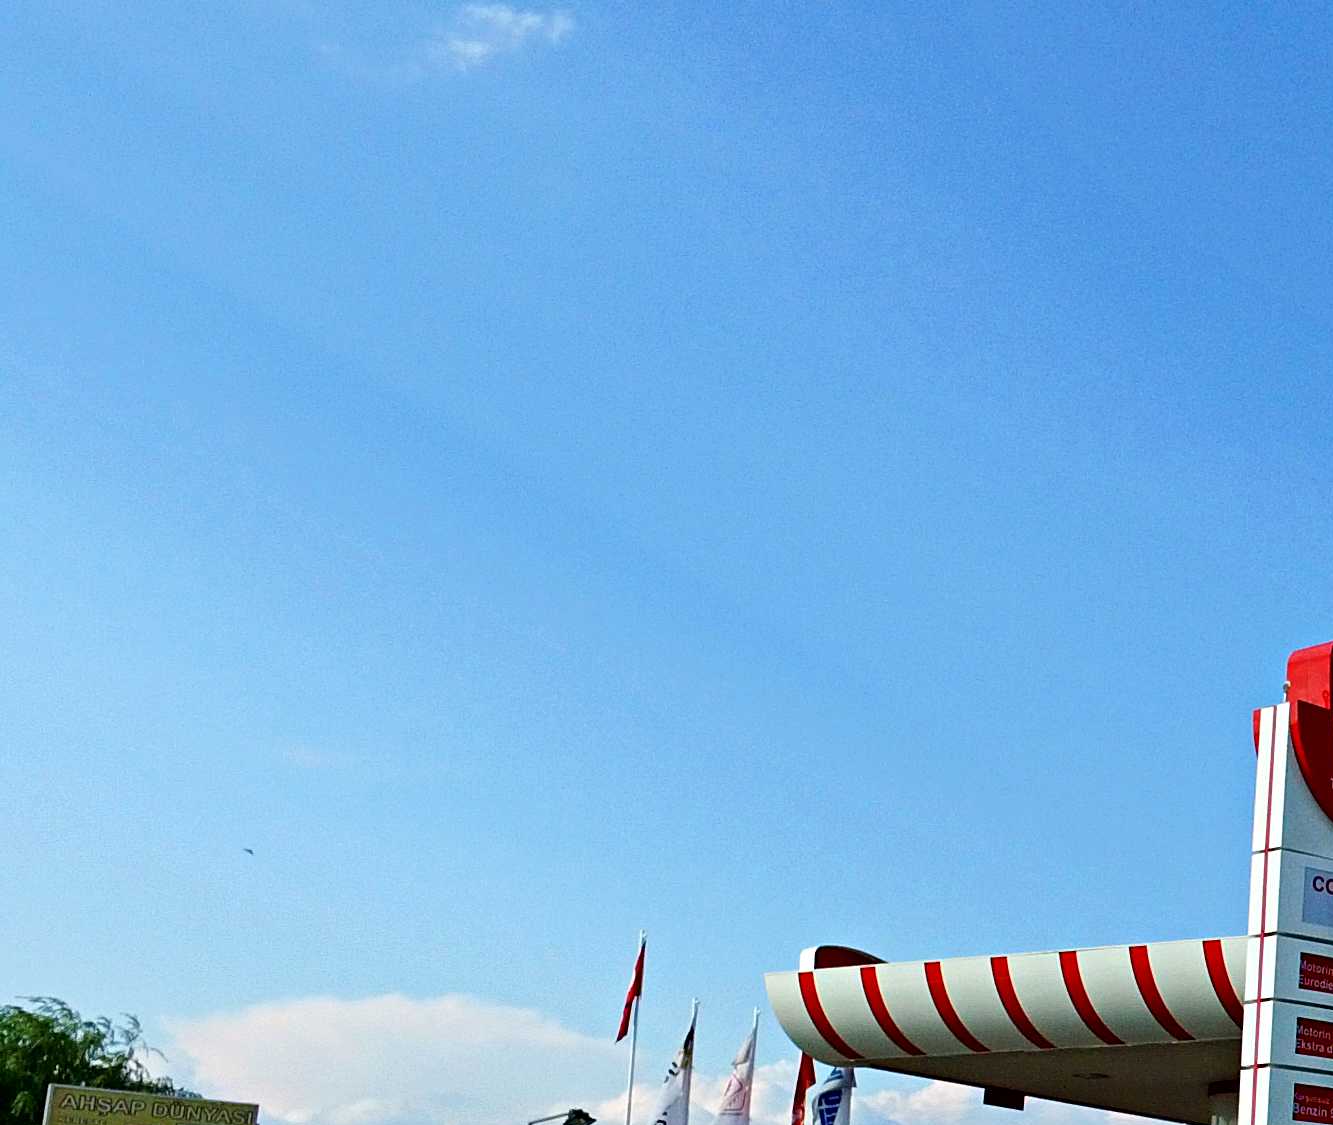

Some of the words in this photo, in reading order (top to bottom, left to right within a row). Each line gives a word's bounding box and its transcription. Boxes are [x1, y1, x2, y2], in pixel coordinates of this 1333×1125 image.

[60, 1094, 145, 1116] AHŞAP
[152, 1101, 253, 1125] DÜNYASI
[1293, 1102, 1327, 1118] Benzin
